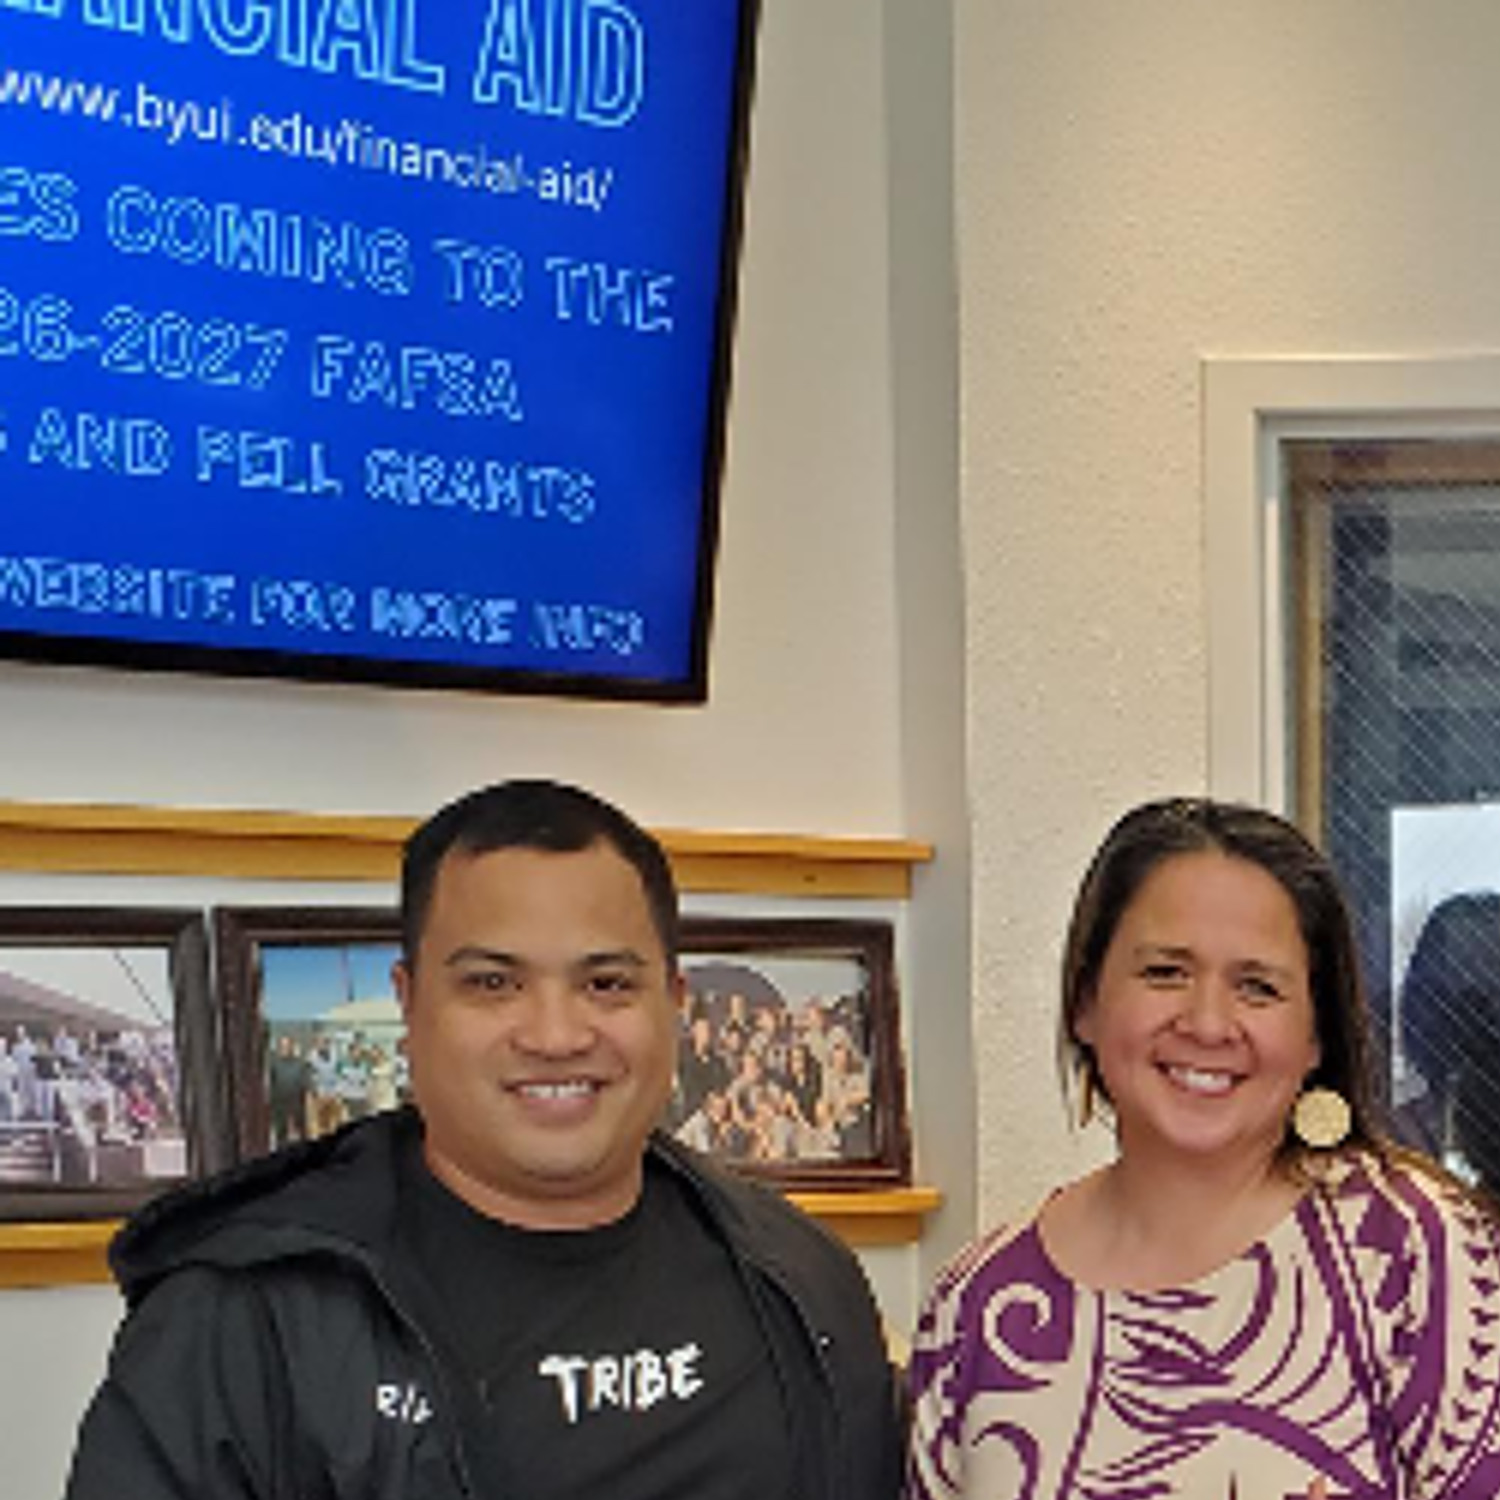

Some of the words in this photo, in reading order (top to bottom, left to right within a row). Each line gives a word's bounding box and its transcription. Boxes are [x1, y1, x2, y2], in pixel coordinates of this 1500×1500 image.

[0, 0, 446, 95] CIAL
[472, 0, 646, 126] AID
[105, 184, 411, 297] COMING
[432, 237, 524, 309] TO
[545, 256, 674, 332] THE
[311, 334, 525, 421] FAFSA
[28, 405, 173, 476] AND
[196, 424, 343, 497] PELL
[364, 448, 596, 524] GRANTS
[538, 1342, 704, 1424] TRIBE
